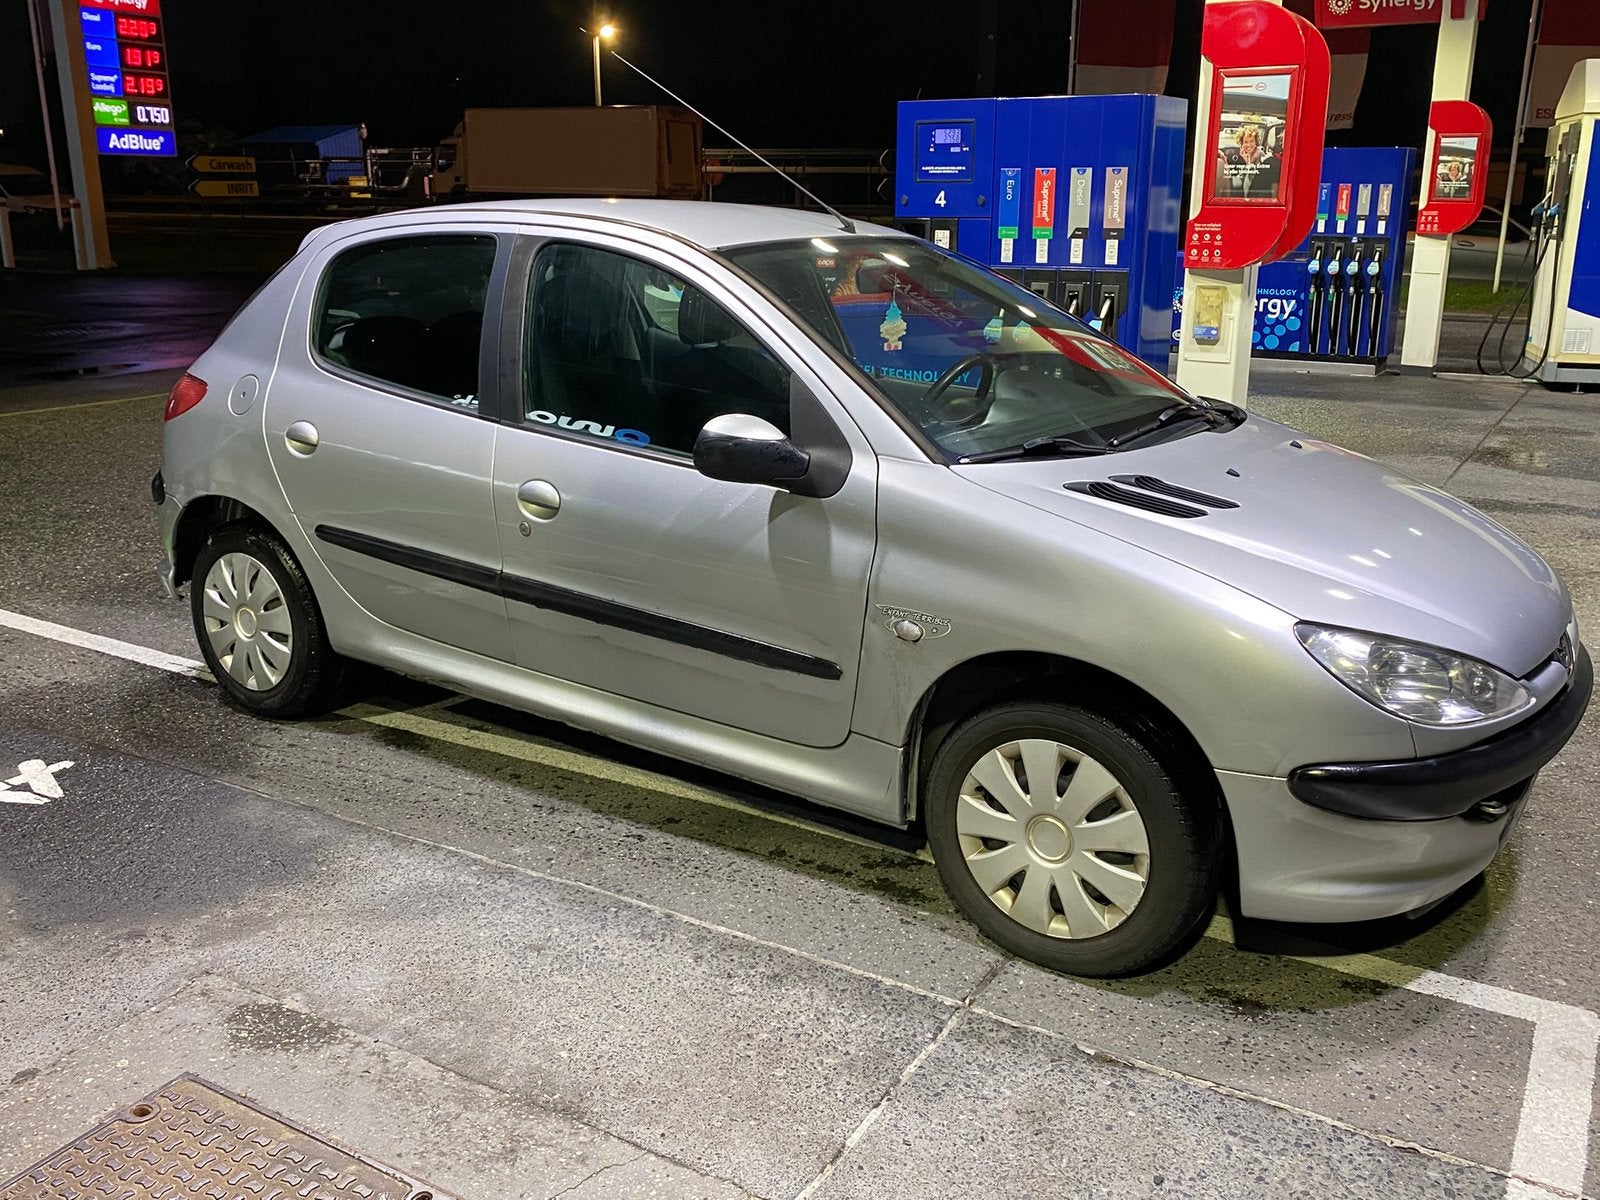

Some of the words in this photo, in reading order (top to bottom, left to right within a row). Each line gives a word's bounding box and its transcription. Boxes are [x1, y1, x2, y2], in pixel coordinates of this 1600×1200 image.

[209, 158, 253, 170] Carwash
[1006, 179, 1015, 201] Euro
[1076, 180, 1086, 206] Diesel
[935, 190, 946, 208] 4
[1257, 288, 1297, 296] HNOLOGY
[882, 606, 910, 618] ENFANT
